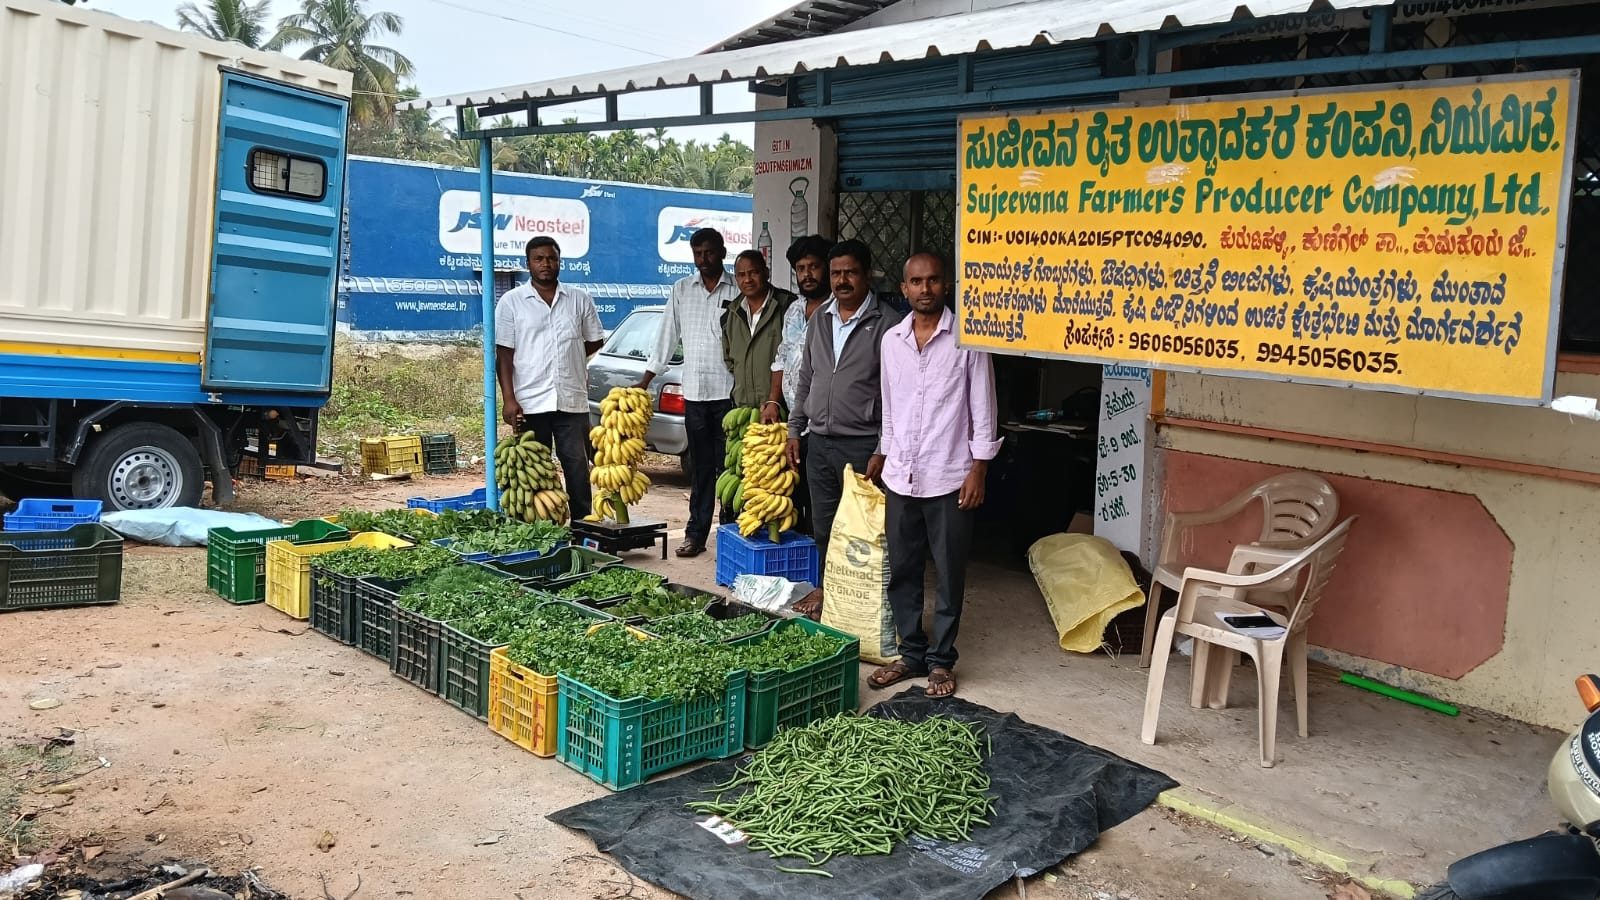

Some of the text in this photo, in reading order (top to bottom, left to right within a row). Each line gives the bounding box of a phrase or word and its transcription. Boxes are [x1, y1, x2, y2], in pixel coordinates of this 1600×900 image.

[966, 118, 1079, 169] ಸುಜೀವನ
[1086, 111, 1133, 177] ರೈತ
[966, 183, 1068, 224] Sujeevana
[1078, 180, 1185, 213] Farmers
[1195, 177, 1334, 214] Producer
[515, 216, 585, 234] Neosteel
